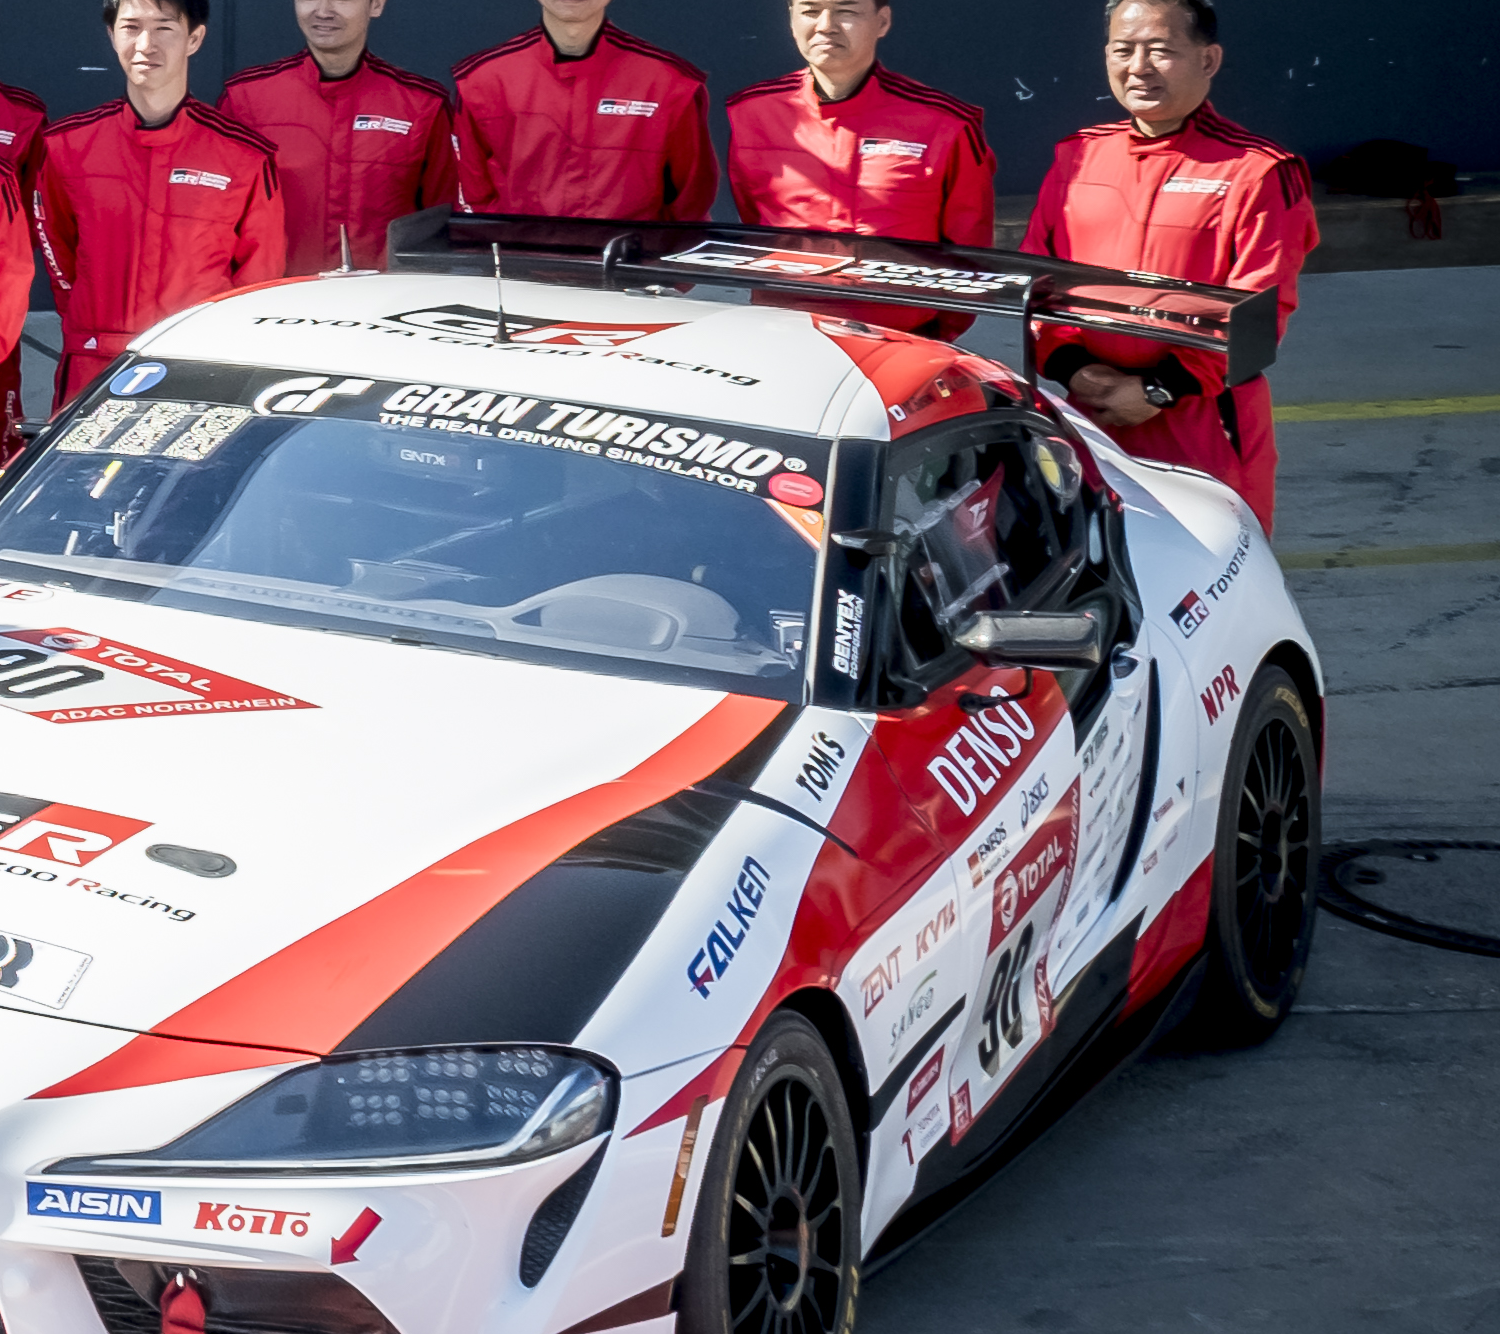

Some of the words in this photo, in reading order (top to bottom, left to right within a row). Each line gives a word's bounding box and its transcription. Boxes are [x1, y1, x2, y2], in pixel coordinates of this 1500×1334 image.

[253, 317, 416, 336] TOYOTA
[428, 336, 591, 356] GAZOO
[602, 351, 761, 386] Racing
[383, 384, 539, 424] GRAN
[537, 403, 782, 477] TURISMO
[92, 645, 212, 701] TOTAL
[1200, 665, 1240, 726] NPR
[49, 705, 128, 723] ADAC
[134, 696, 296, 718] NORDRHEIN
[795, 731, 845, 803] TOM'S
[927, 682, 1034, 816] DENSO
[65, 877, 197, 923] Racing
[687, 855, 770, 999] FALKEN
[37, 1189, 152, 1218] AISIN
